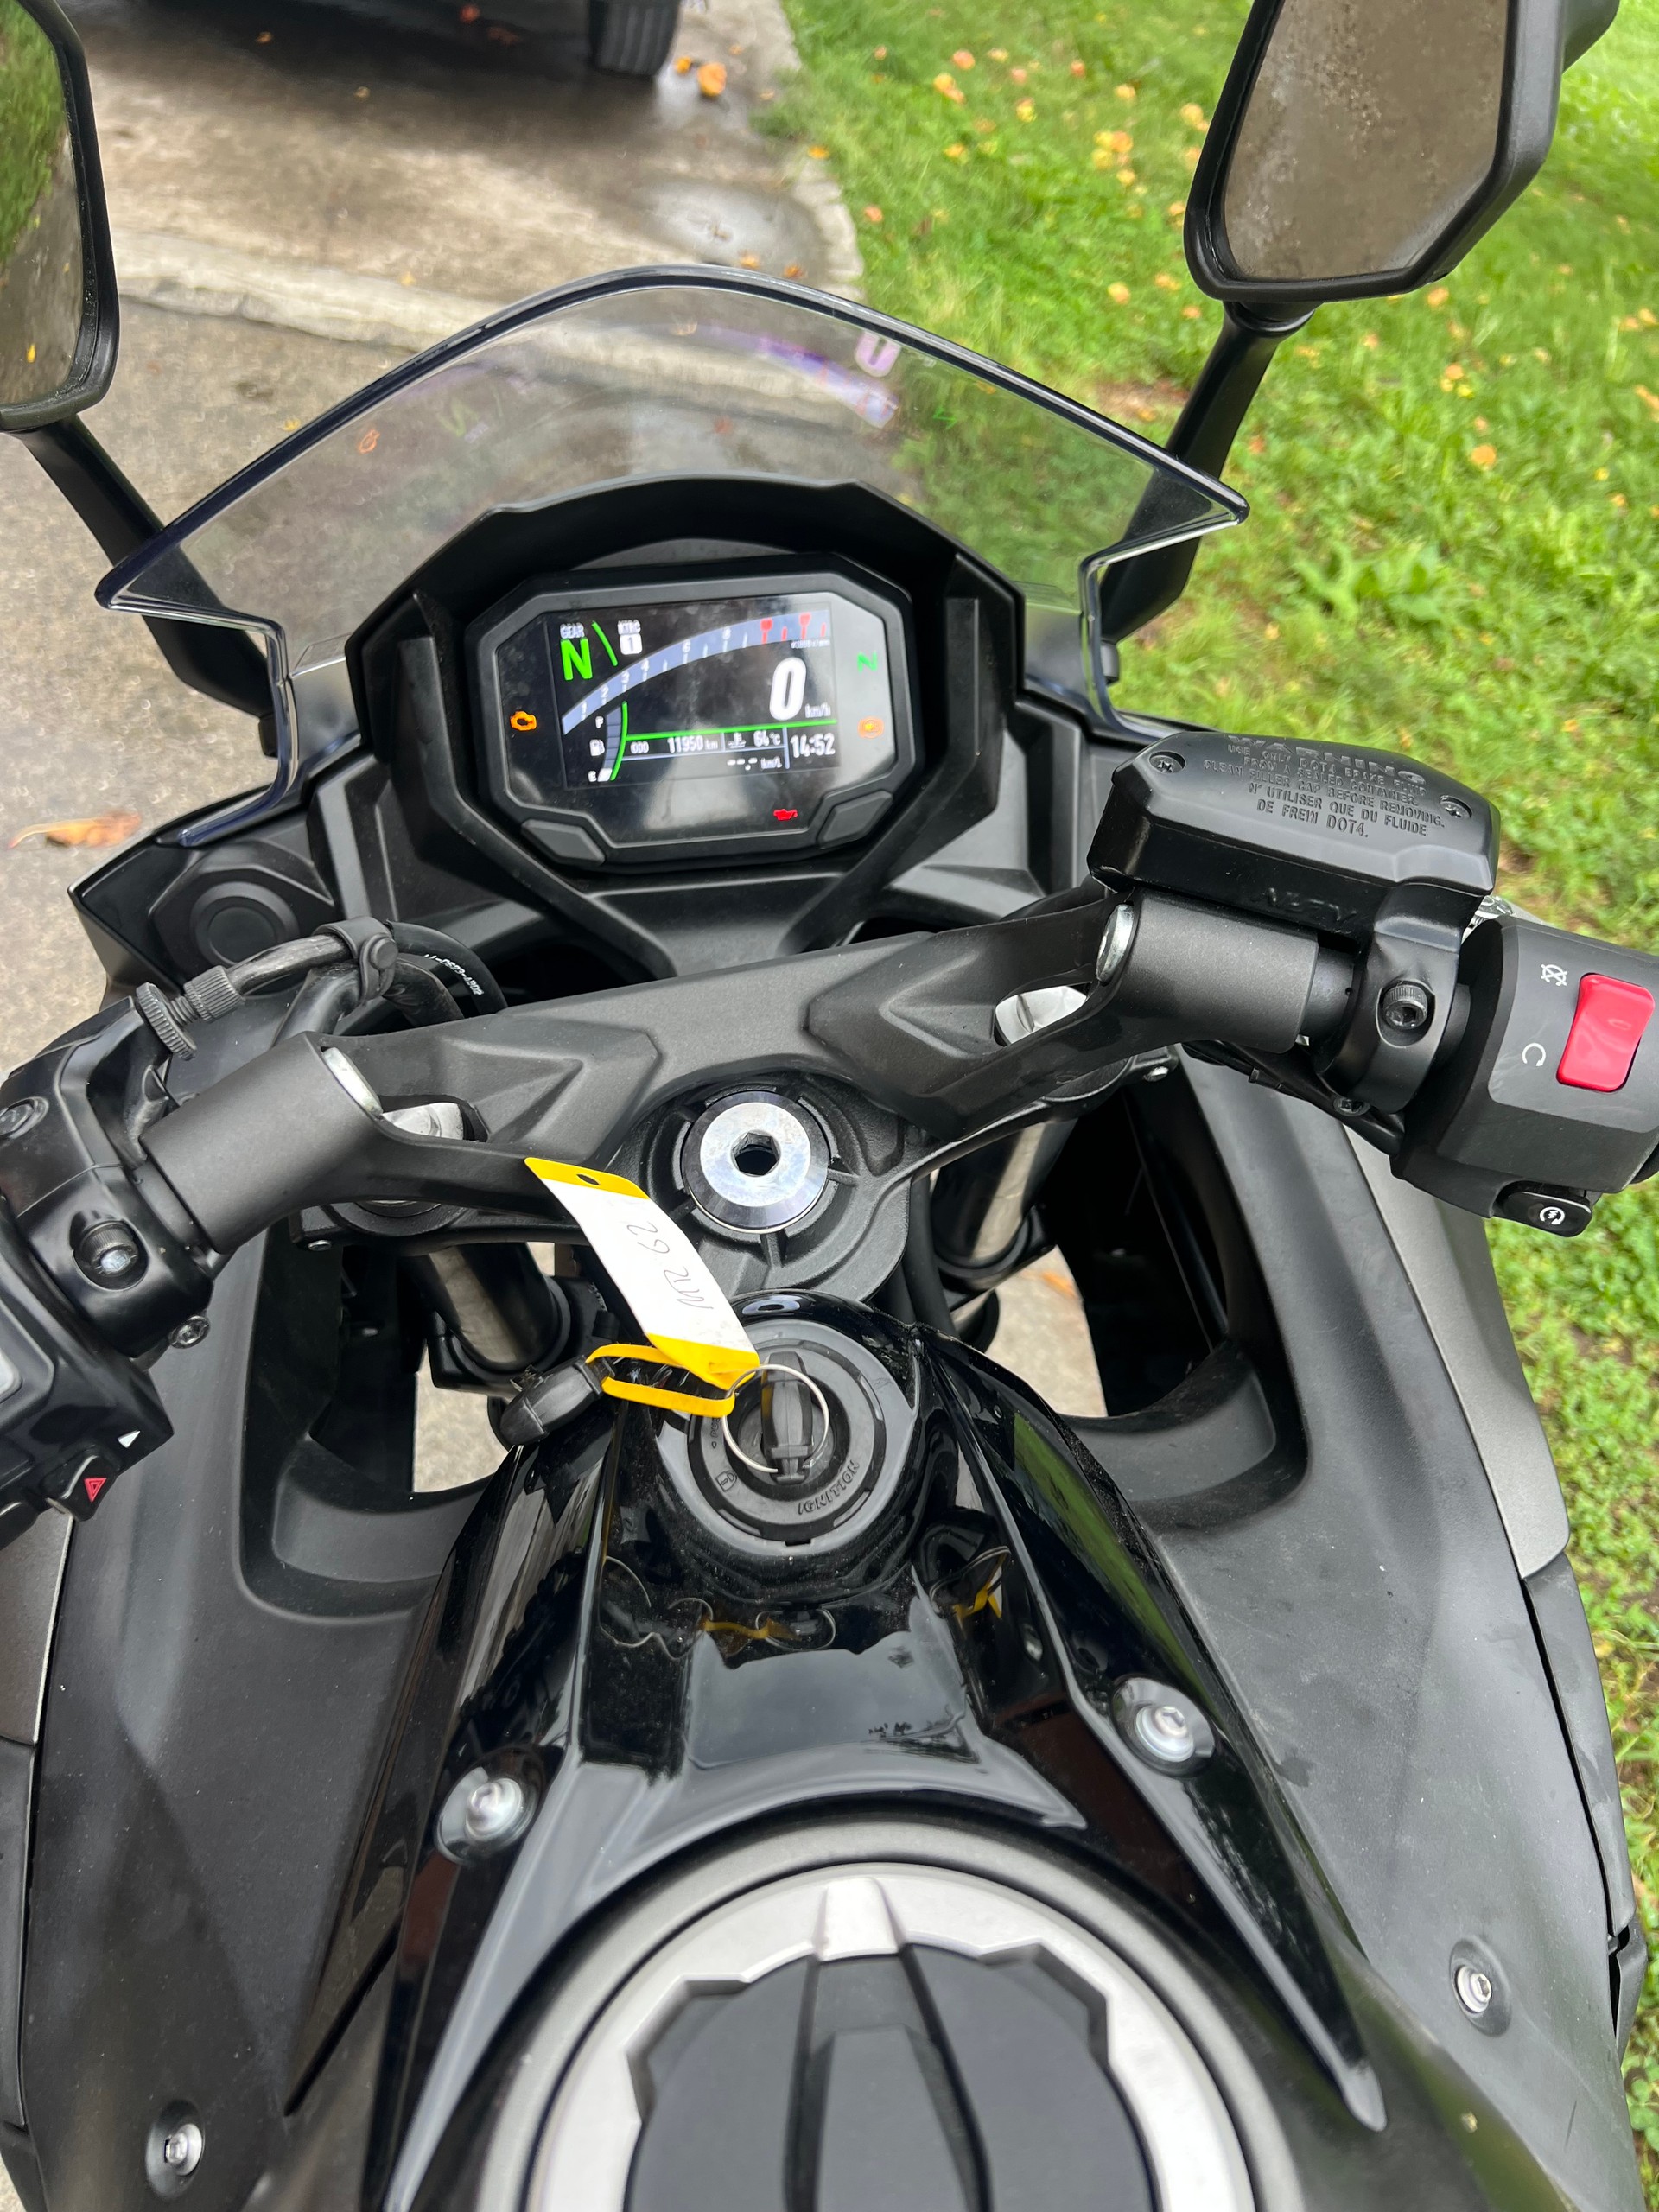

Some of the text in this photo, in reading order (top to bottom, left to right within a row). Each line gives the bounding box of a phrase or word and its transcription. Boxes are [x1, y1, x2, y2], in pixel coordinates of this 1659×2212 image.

[560, 622, 585, 639] GEAR
[560, 638, 593, 681] N
[857, 652, 879, 672] N
[769, 657, 807, 721] 0
[595, 716, 604, 729] F
[790, 733, 836, 759] 14:52
[1227, 744, 1251, 756] USE
[1261, 750, 1292, 764] ONLY
[1300, 757, 1337, 774] DOT4
[1344, 767, 1384, 785] BRAKE
[1243, 756, 1278, 772] FROM
[1283, 765, 1291, 775] A
[1297, 767, 1344, 786] SEALED
[1203, 760, 1243, 777] CLEAN
[1298, 779, 1321, 794] CAP
[1327, 786, 1375, 808] BEFORE
[1380, 799, 1445, 828] REMOVING.
[1266, 786, 1323, 810] UTILISER
[1329, 801, 1355, 817] QUE
[1360, 808, 1378, 823] DU
[1384, 814, 1427, 836] FLUIDE
[1256, 798, 1369, 838] DE FREIN DOT4.
[798, 1459, 861, 1516] IGNITION
